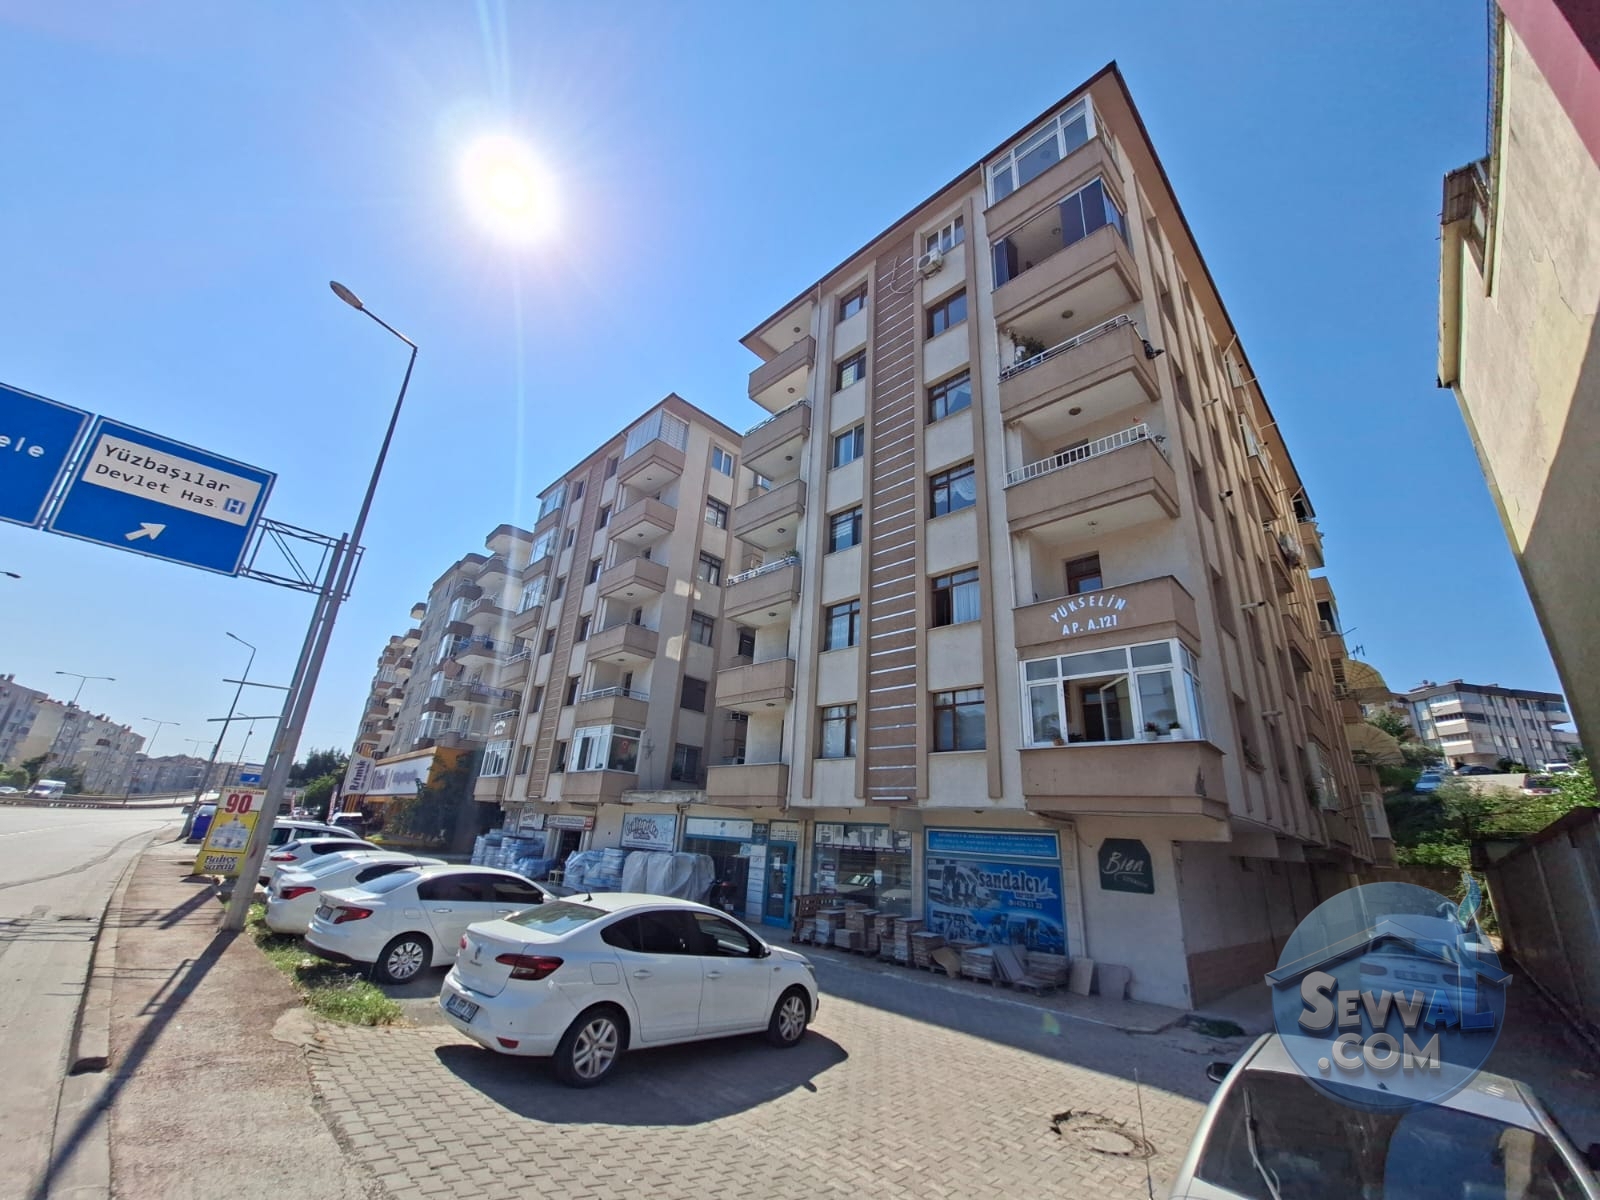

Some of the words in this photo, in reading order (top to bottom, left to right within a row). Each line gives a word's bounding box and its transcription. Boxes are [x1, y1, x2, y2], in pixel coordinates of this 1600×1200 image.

[104, 443, 230, 493] Yüzbaşılar
[95, 464, 169, 494] Devlet
[180, 488, 218, 508] Has.
[1062, 622, 1084, 636] AP.
[1087, 614, 1118, 631] A.121
[224, 793, 253, 814] 90
[1102, 851, 1145, 874] Bien
